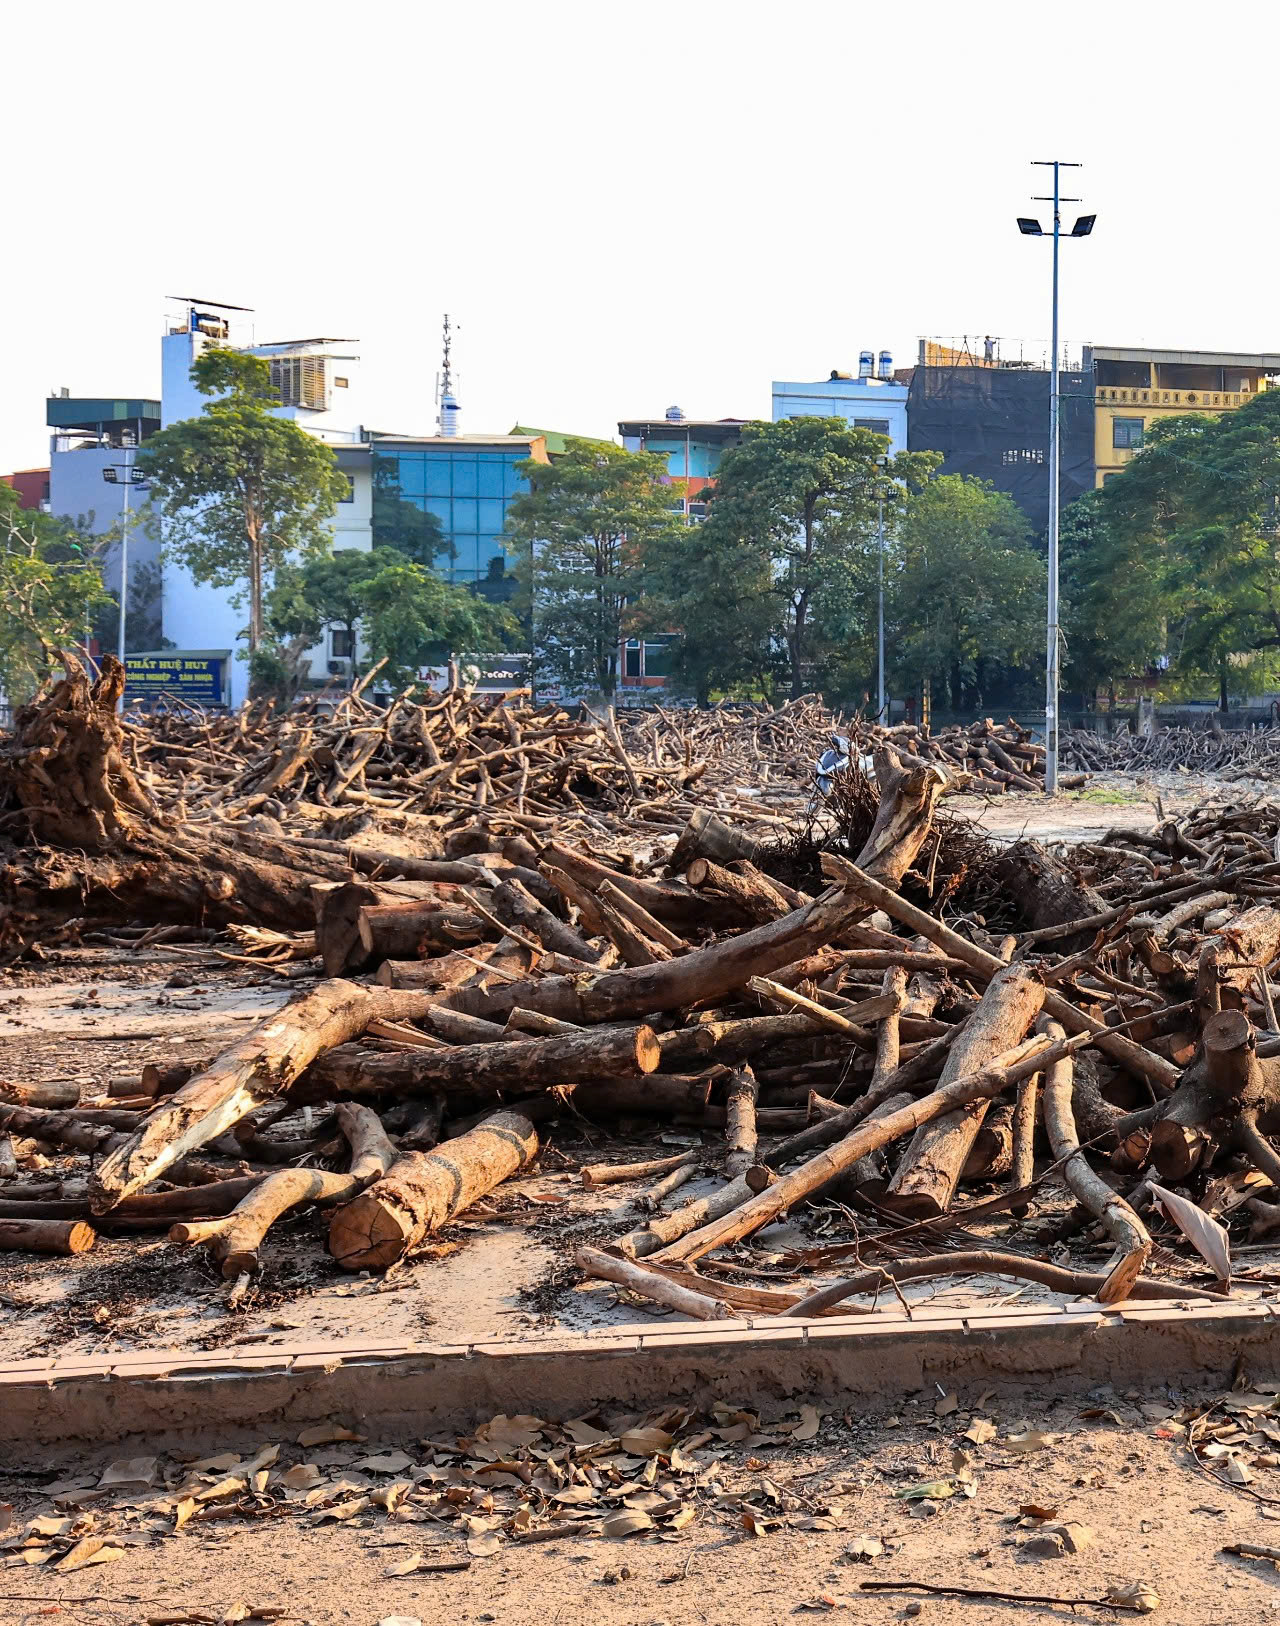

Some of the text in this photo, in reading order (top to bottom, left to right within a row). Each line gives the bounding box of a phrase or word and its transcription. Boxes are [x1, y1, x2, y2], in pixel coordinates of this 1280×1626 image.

[126, 657, 208, 671] THẤT HUỆ HUY
